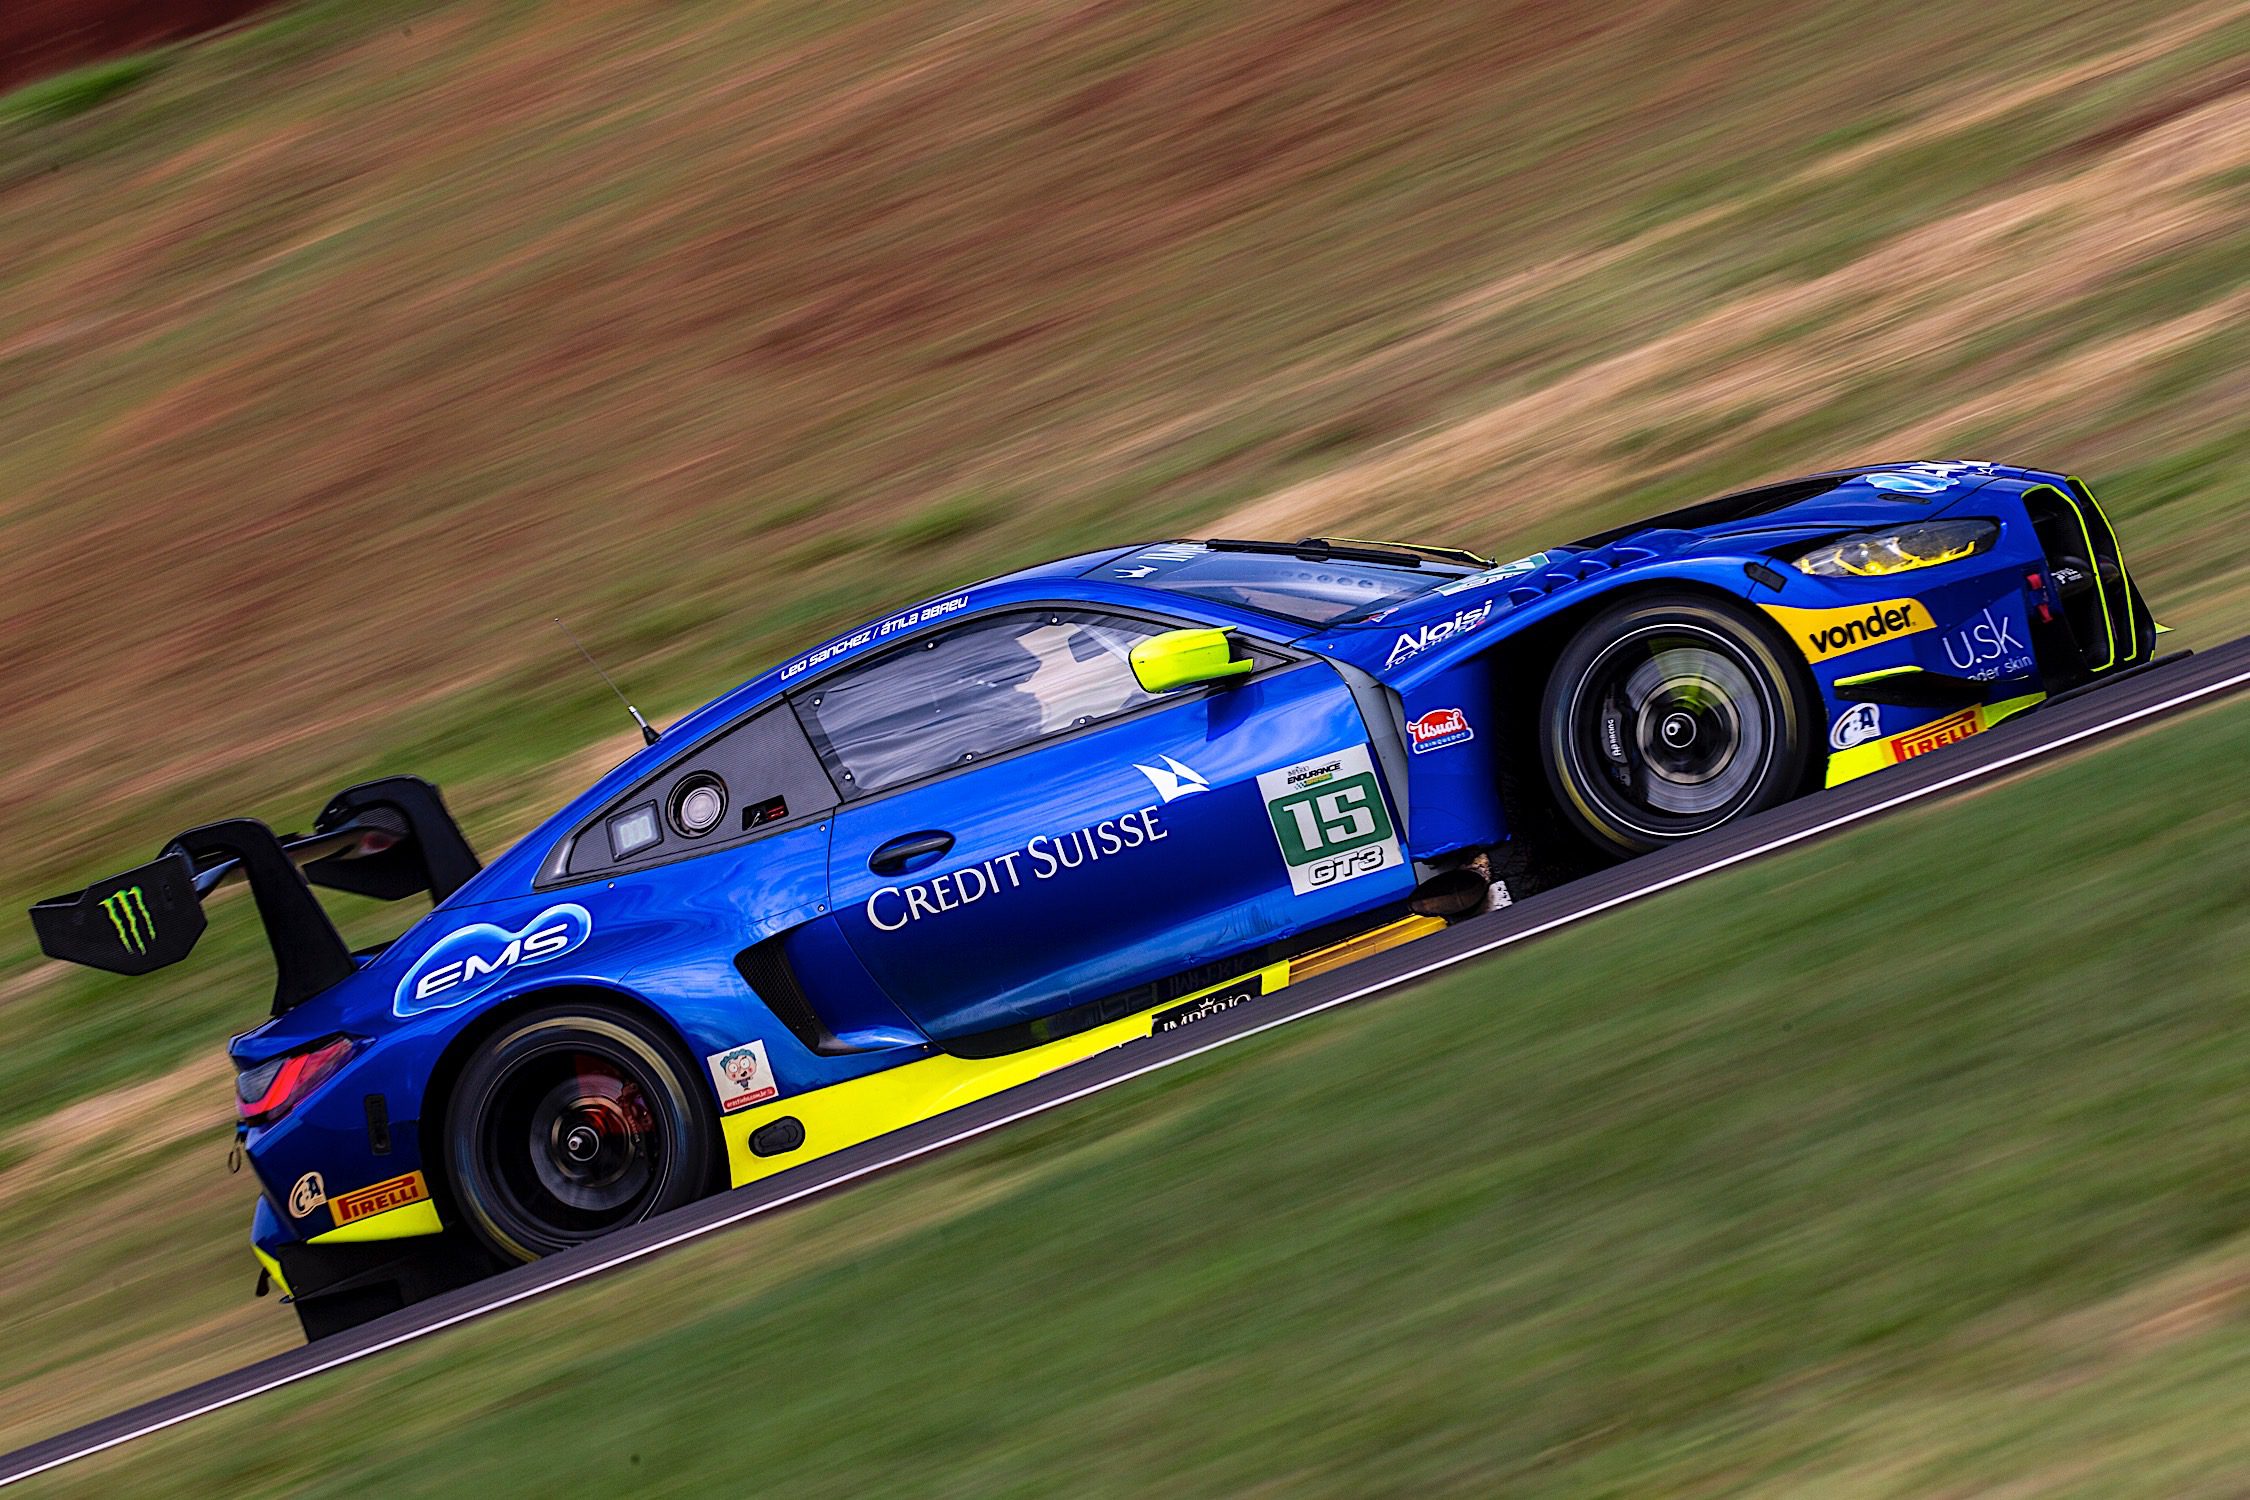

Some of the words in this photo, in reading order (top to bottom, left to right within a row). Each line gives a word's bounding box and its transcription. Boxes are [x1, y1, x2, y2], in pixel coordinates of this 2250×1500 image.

[1385, 599, 1493, 667] Aloisi
[1809, 604, 1911, 653] vonder
[1410, 711, 1463, 739] Usual
[1890, 710, 1979, 762] PIRELLI
[1287, 762, 1342, 785] ENDURANCE
[1283, 785, 1376, 851] 15
[867, 851, 1021, 931] CREDIT
[1027, 804, 1168, 879] SUISSE
[1309, 845, 1384, 886] GT3
[415, 923, 568, 1000] EMS
[337, 1175, 419, 1221] PIRELLI
